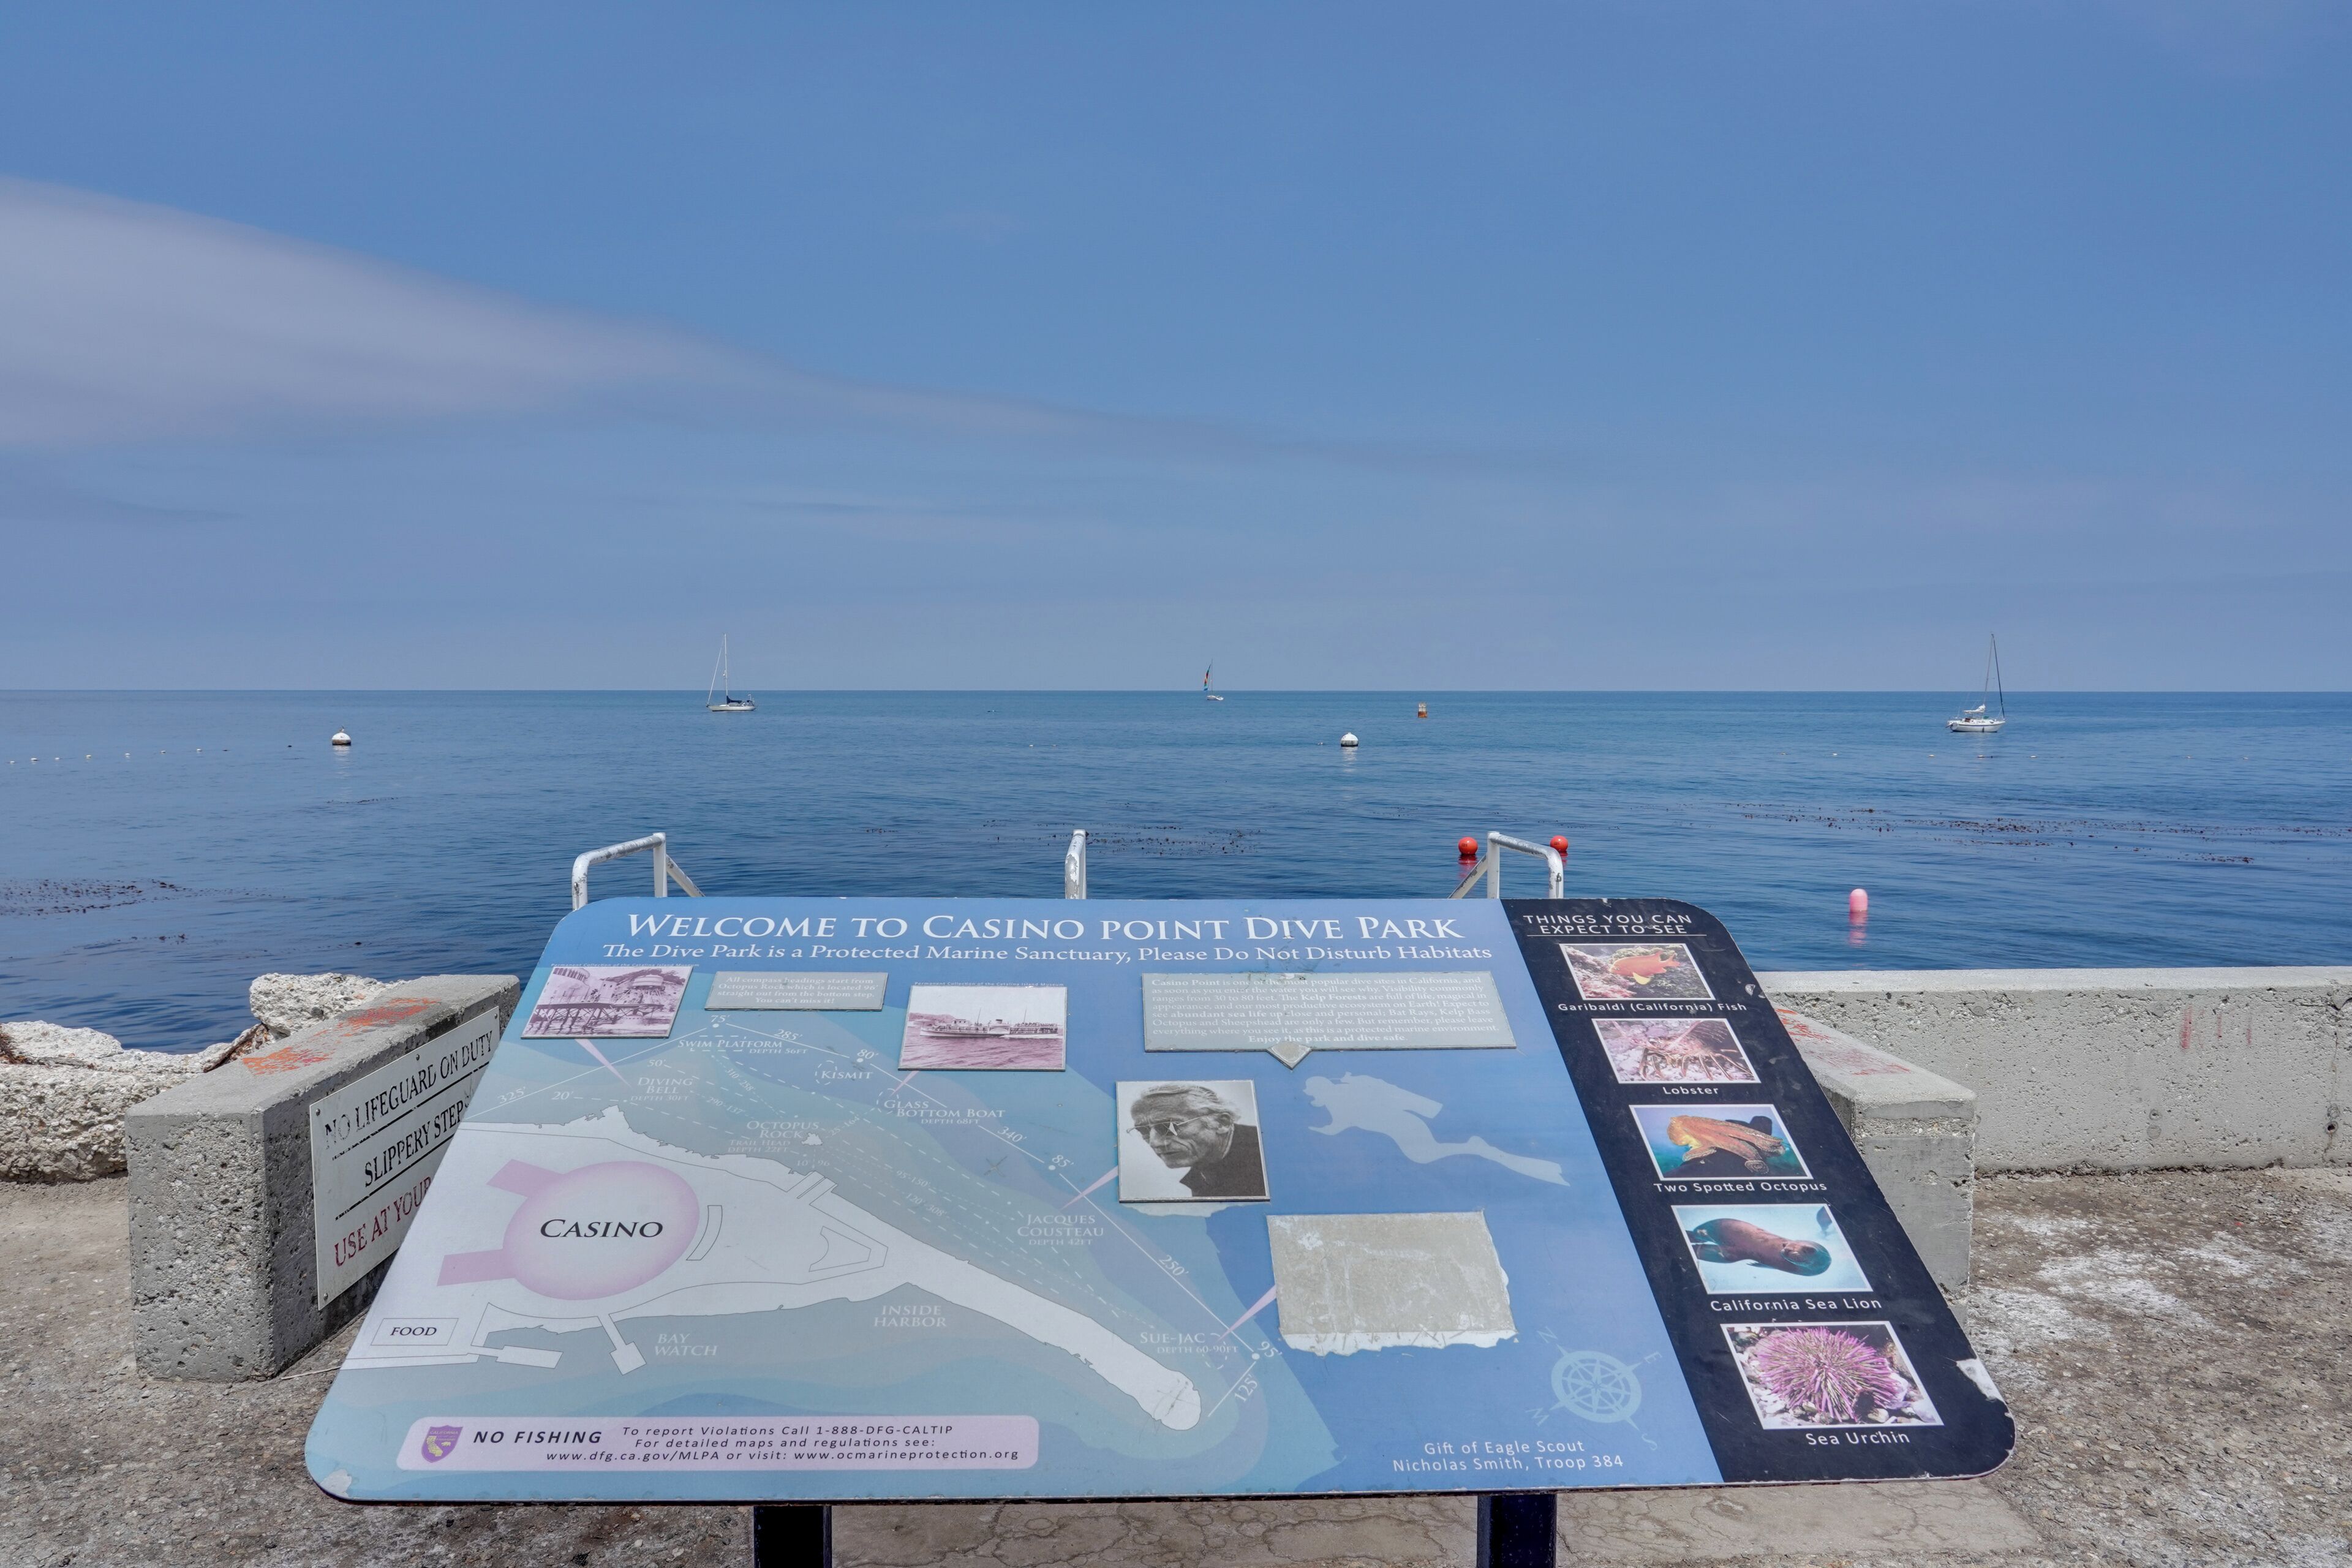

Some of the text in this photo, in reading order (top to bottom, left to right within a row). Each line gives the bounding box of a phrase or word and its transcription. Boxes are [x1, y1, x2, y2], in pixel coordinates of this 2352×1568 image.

[851, 918, 907, 937] TO
[603, 944, 644, 957] The
[649, 944, 704, 957] Dive
[706, 944, 762, 957] Park
[767, 946, 785, 957] is
[810, 945, 919, 958] Protected
[925, 946, 1008, 959] Marine
[1016, 947, 1131, 964] Sanctuary,
[1139, 948, 1207, 960] Please
[1214, 948, 1248, 959] Do
[1254, 948, 1300, 959] Not
[1305, 946, 1390, 959] Disturb
[1396, 946, 1491, 958] Habitats
[1630, 1003, 1713, 1012] (California)
[773, 1028, 802, 1041] 285'
[1305, 1035, 1330, 1044] park
[857, 1049, 879, 1060] 80'
[324, 1031, 493, 1149] NO LIFEGUARD ON DUTY
[497, 1087, 527, 1104] 325'
[551, 1091, 573, 1100] 20'
[997, 1125, 1027, 1144] 340'
[364, 1121, 431, 1188] SLIPPERY
[1052, 1154, 1074, 1169] 85'
[1654, 1182, 1826, 1193] Two Spotted Octopus
[334, 1224, 367, 1268] USE
[371, 1205, 392, 1238] AT
[1158, 1254, 1189, 1277] 250'
[882, 1305, 941, 1315] INSIDE
[1711, 1298, 1882, 1311] California Sea Lion
[875, 1317, 946, 1327] HARBOR
[658, 1333, 690, 1343] BAY
[655, 1346, 717, 1355] WATCH
[1257, 1341, 1282, 1357] 95'
[1234, 1374, 1258, 1403] 125'
[473, 1431, 601, 1443] NO FISHING
[646, 1428, 693, 1437] report
[782, 1426, 809, 1434] Call
[816, 1426, 952, 1434] 1-888-DFG-CALTIP
[1806, 1431, 1910, 1445] Sea Urchin
[666, 1439, 728, 1447] detailed
[736, 1440, 772, 1449] maps
[781, 1438, 807, 1447] and
[814, 1438, 897, 1449] regulations
[1425, 1441, 1585, 1455] Gift of Eagle Scout
[547, 1451, 718, 1462] www.dfg.ca.gov/MLPA
[749, 1451, 786, 1460] visit:
[794, 1450, 1017, 1460] www.ocmarineprotection.org
[1393, 1455, 1623, 1471] Nicholas Smith, Troop 384
